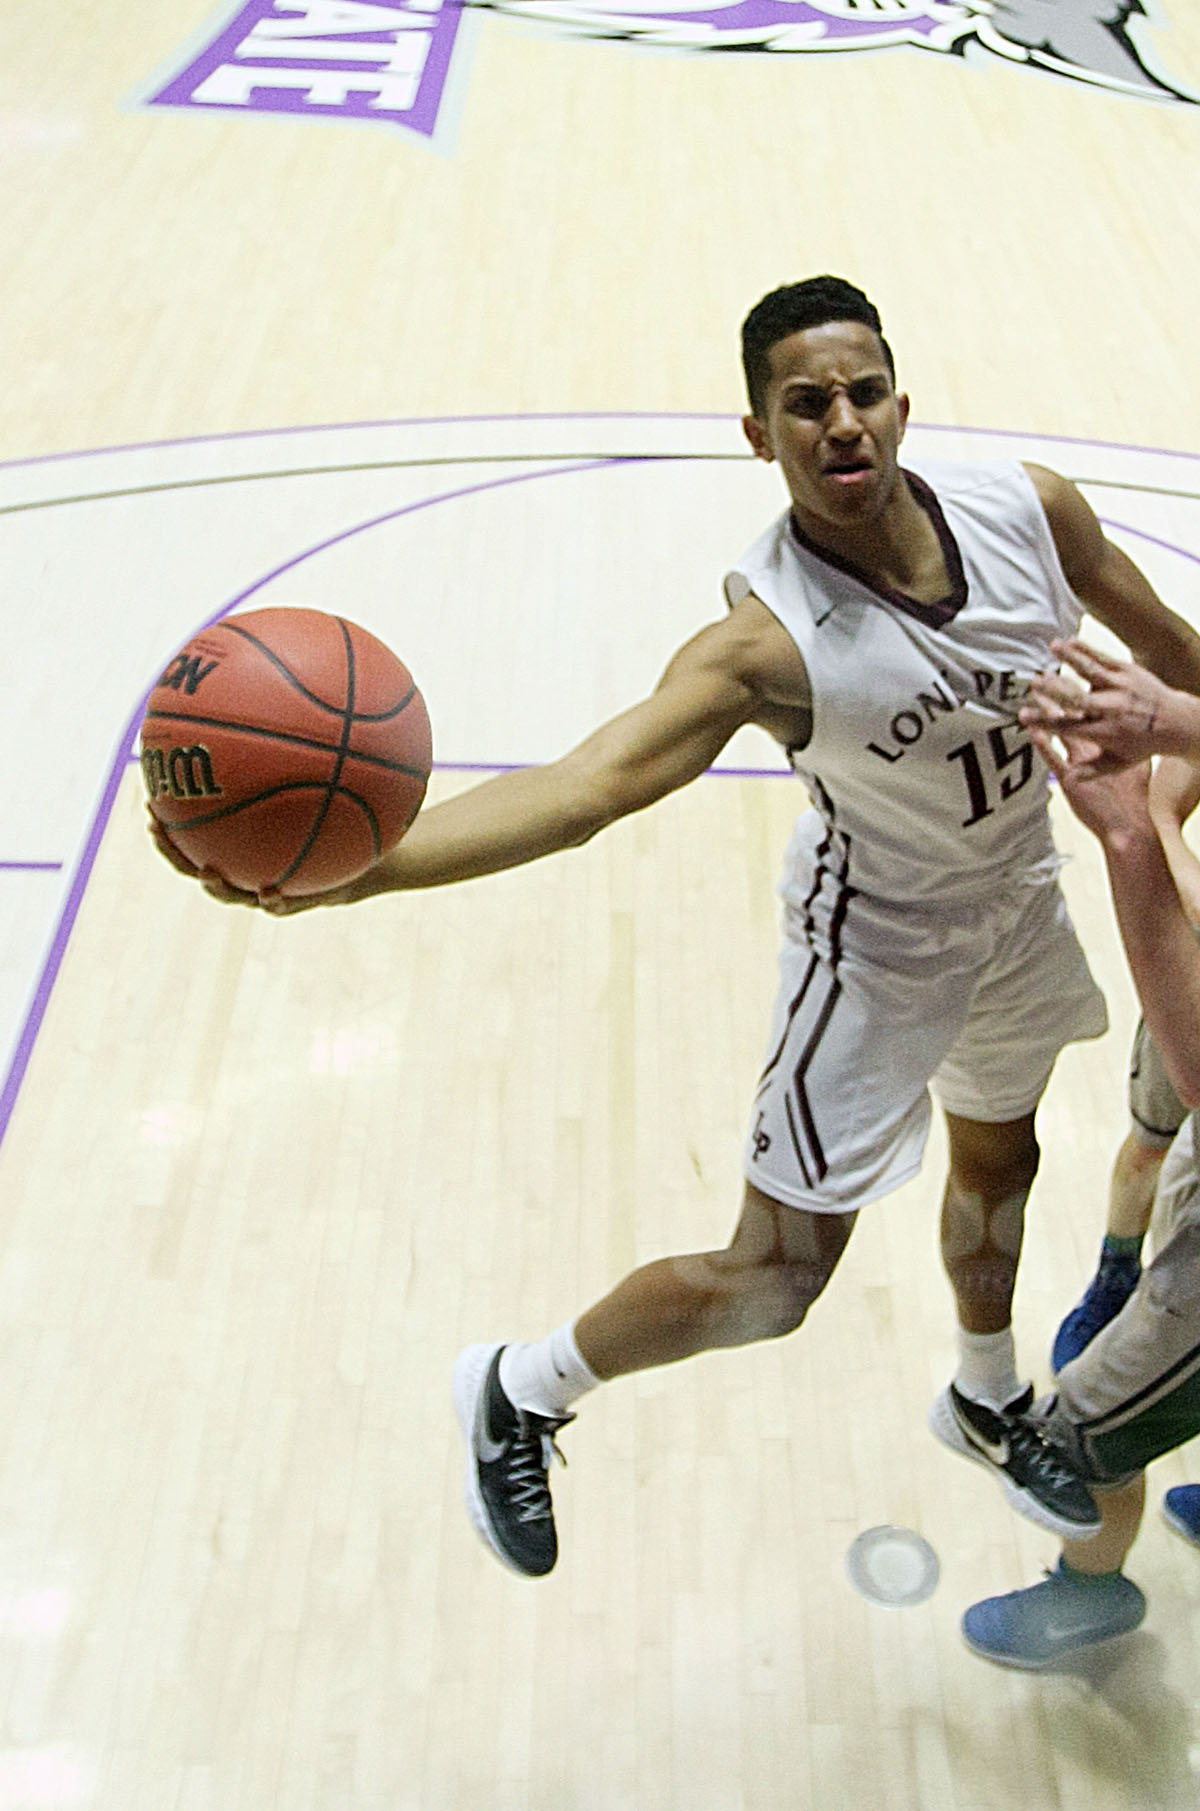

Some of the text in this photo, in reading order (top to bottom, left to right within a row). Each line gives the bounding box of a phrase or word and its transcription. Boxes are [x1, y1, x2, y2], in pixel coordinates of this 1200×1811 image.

[190, 0, 440, 111] ATE
[866, 668, 965, 763] LON
[946, 715, 1034, 828] 15
